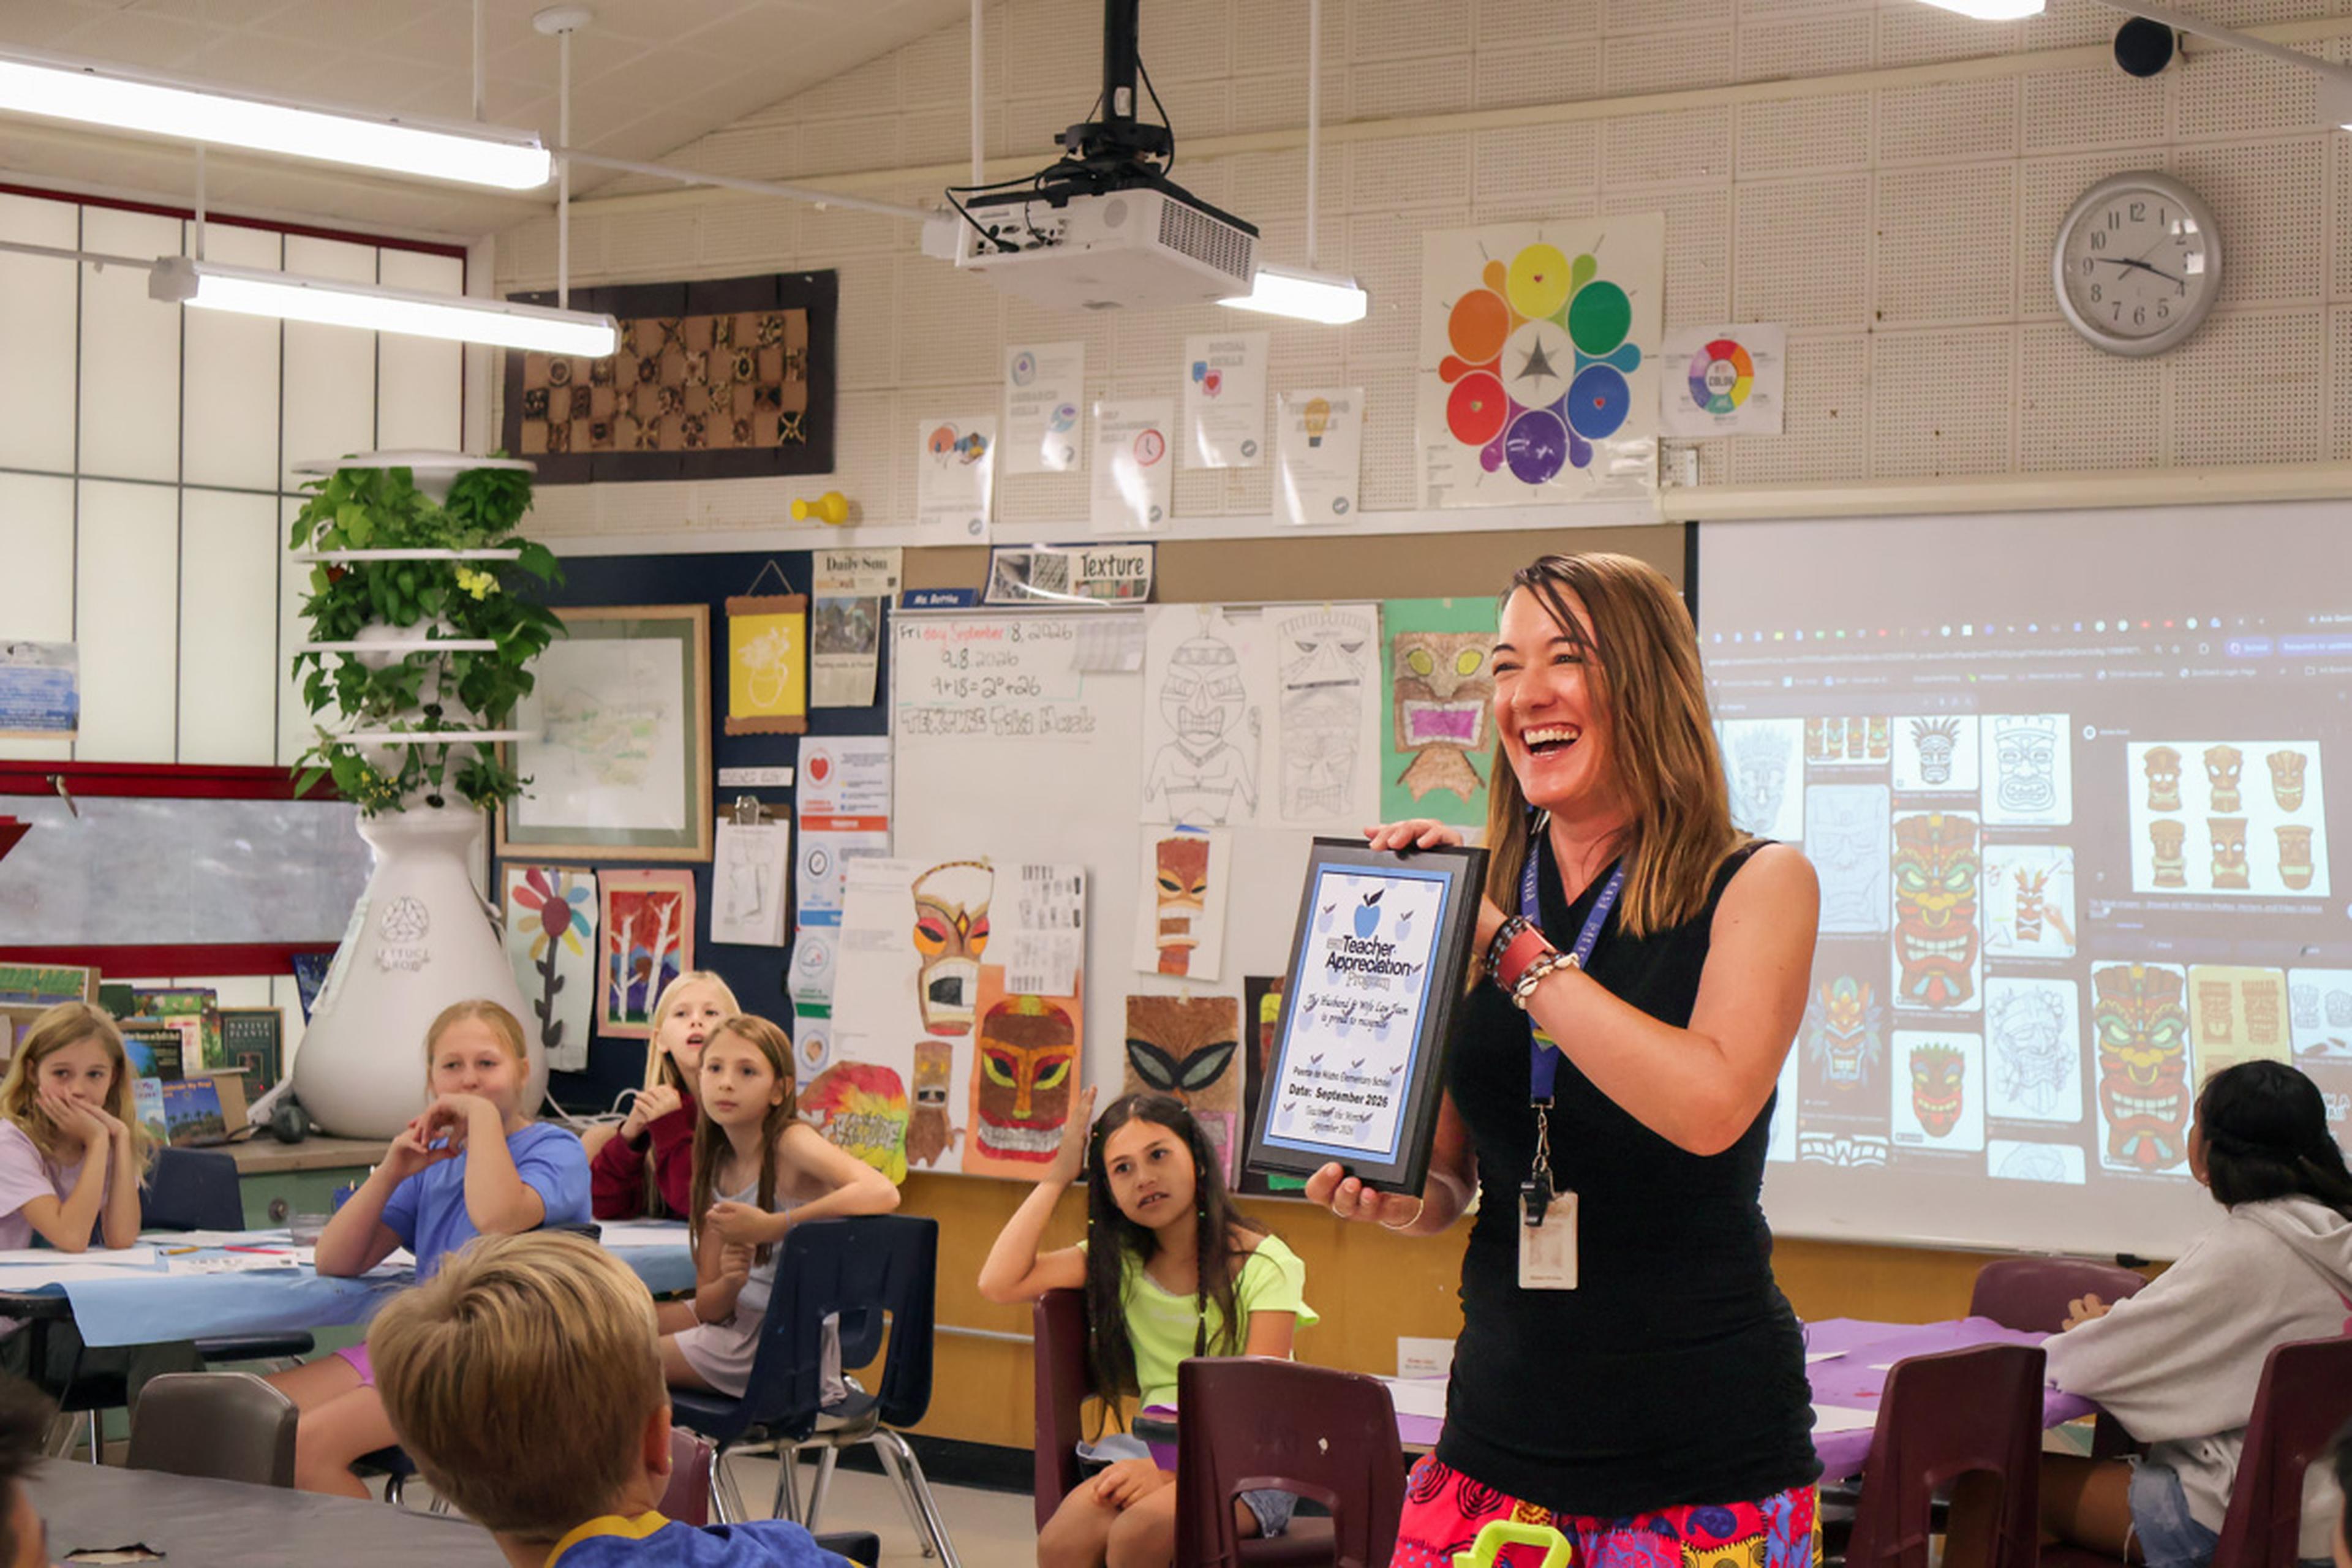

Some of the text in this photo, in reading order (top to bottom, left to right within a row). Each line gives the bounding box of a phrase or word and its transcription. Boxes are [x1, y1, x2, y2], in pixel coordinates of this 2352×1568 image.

[2108, 211, 2119, 230] 11
[2130, 202, 2146, 222] 12
[2160, 208, 2165, 226] 1
[2090, 231, 2106, 251] 10
[2083, 257, 2094, 276] 9
[2090, 284, 2101, 303] 8
[2112, 301, 2122, 321] 7
[2133, 306, 2145, 326] 6
[2157, 298, 2169, 318] 5
[827, 556, 888, 574] Daily Sun
[1082, 552, 1145, 577] Texture
[1344, 935, 1395, 958] Teacher
[1325, 952, 1410, 977] Appreciation
[1316, 1087, 1364, 1104] September
[1365, 1094, 1389, 1108] 2026
